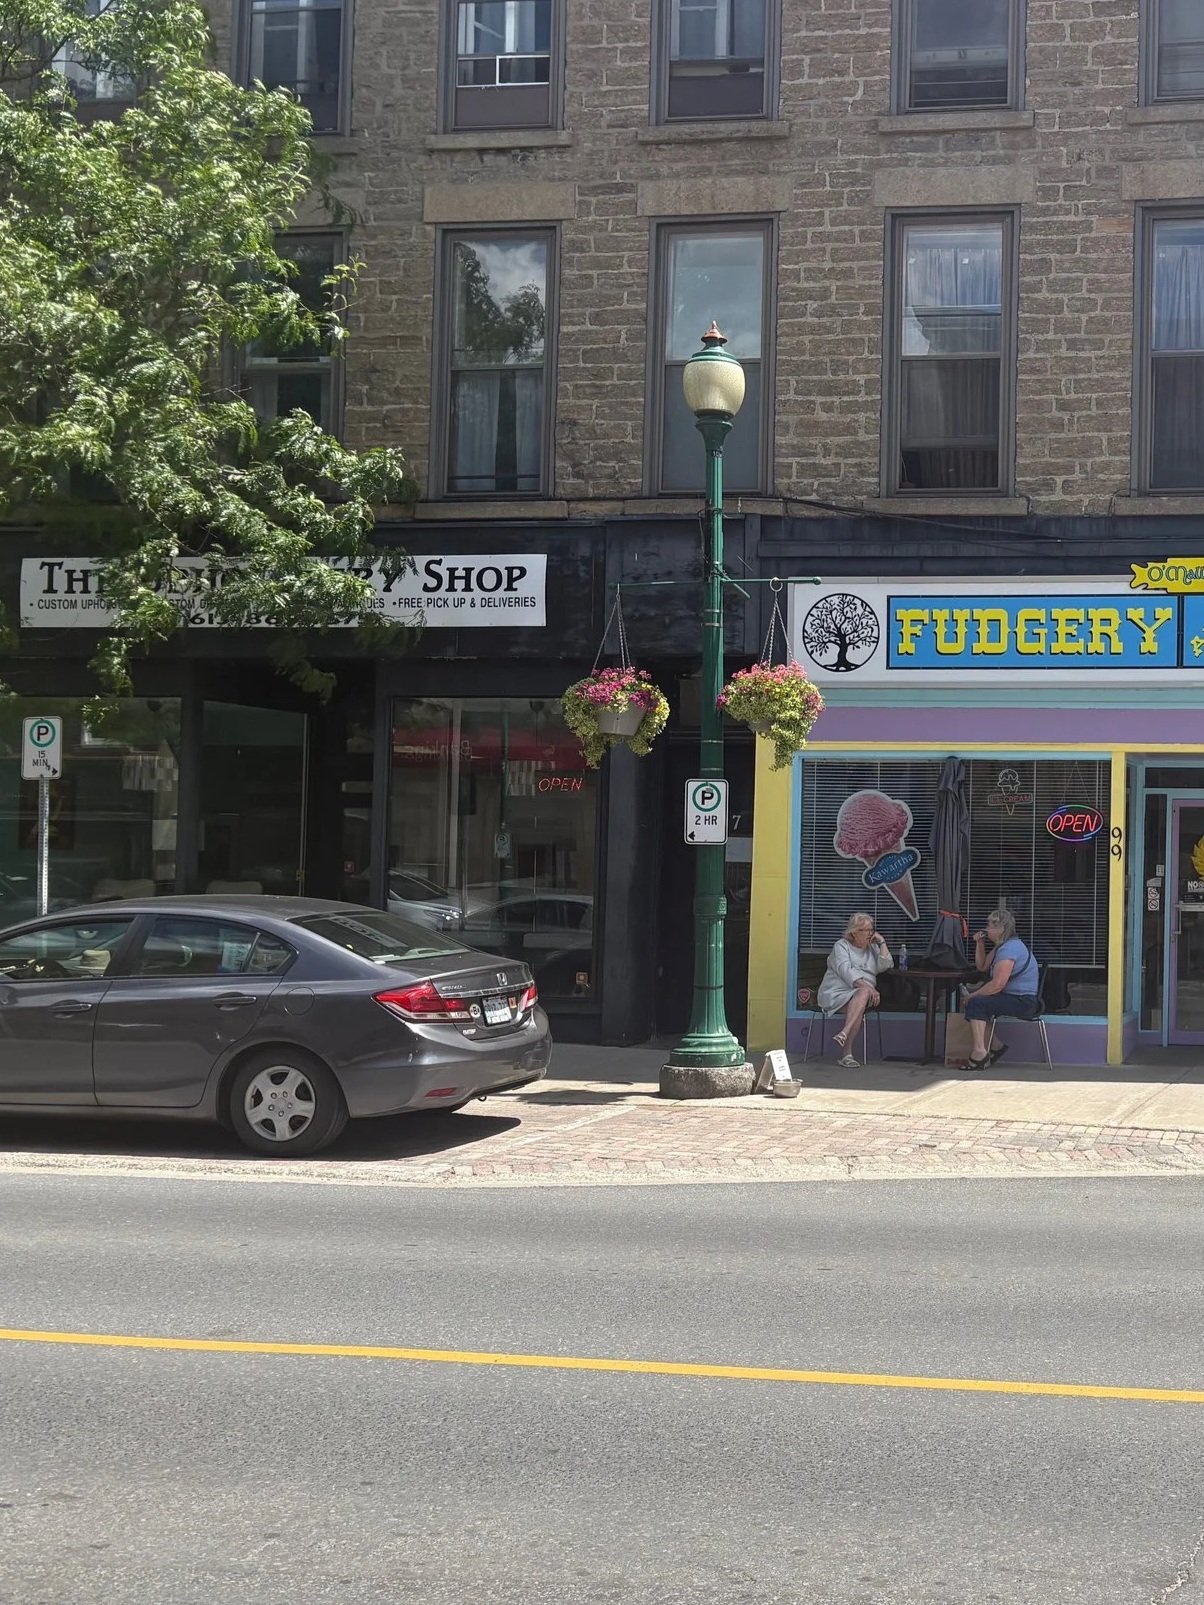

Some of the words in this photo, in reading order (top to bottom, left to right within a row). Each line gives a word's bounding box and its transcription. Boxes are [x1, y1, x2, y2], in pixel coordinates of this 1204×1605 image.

[37, 599, 77, 609] CUSTOM
[398, 597, 423, 608] FREE
[426, 597, 449, 608] PICK
[453, 597, 466, 608] UP
[470, 597, 476, 608] &
[480, 596, 536, 608] DELIVERIES
[895, 607, 1173, 655] FUDGERY
[37, 725, 49, 741] P
[37, 750, 46, 759] 15
[538, 777, 583, 791] OPEN
[701, 789, 714, 805] P
[695, 815, 701, 825] 2
[704, 815, 718, 825] HR
[1050, 814, 1098, 832] OPEN
[868, 854, 914, 883] Kawartha
